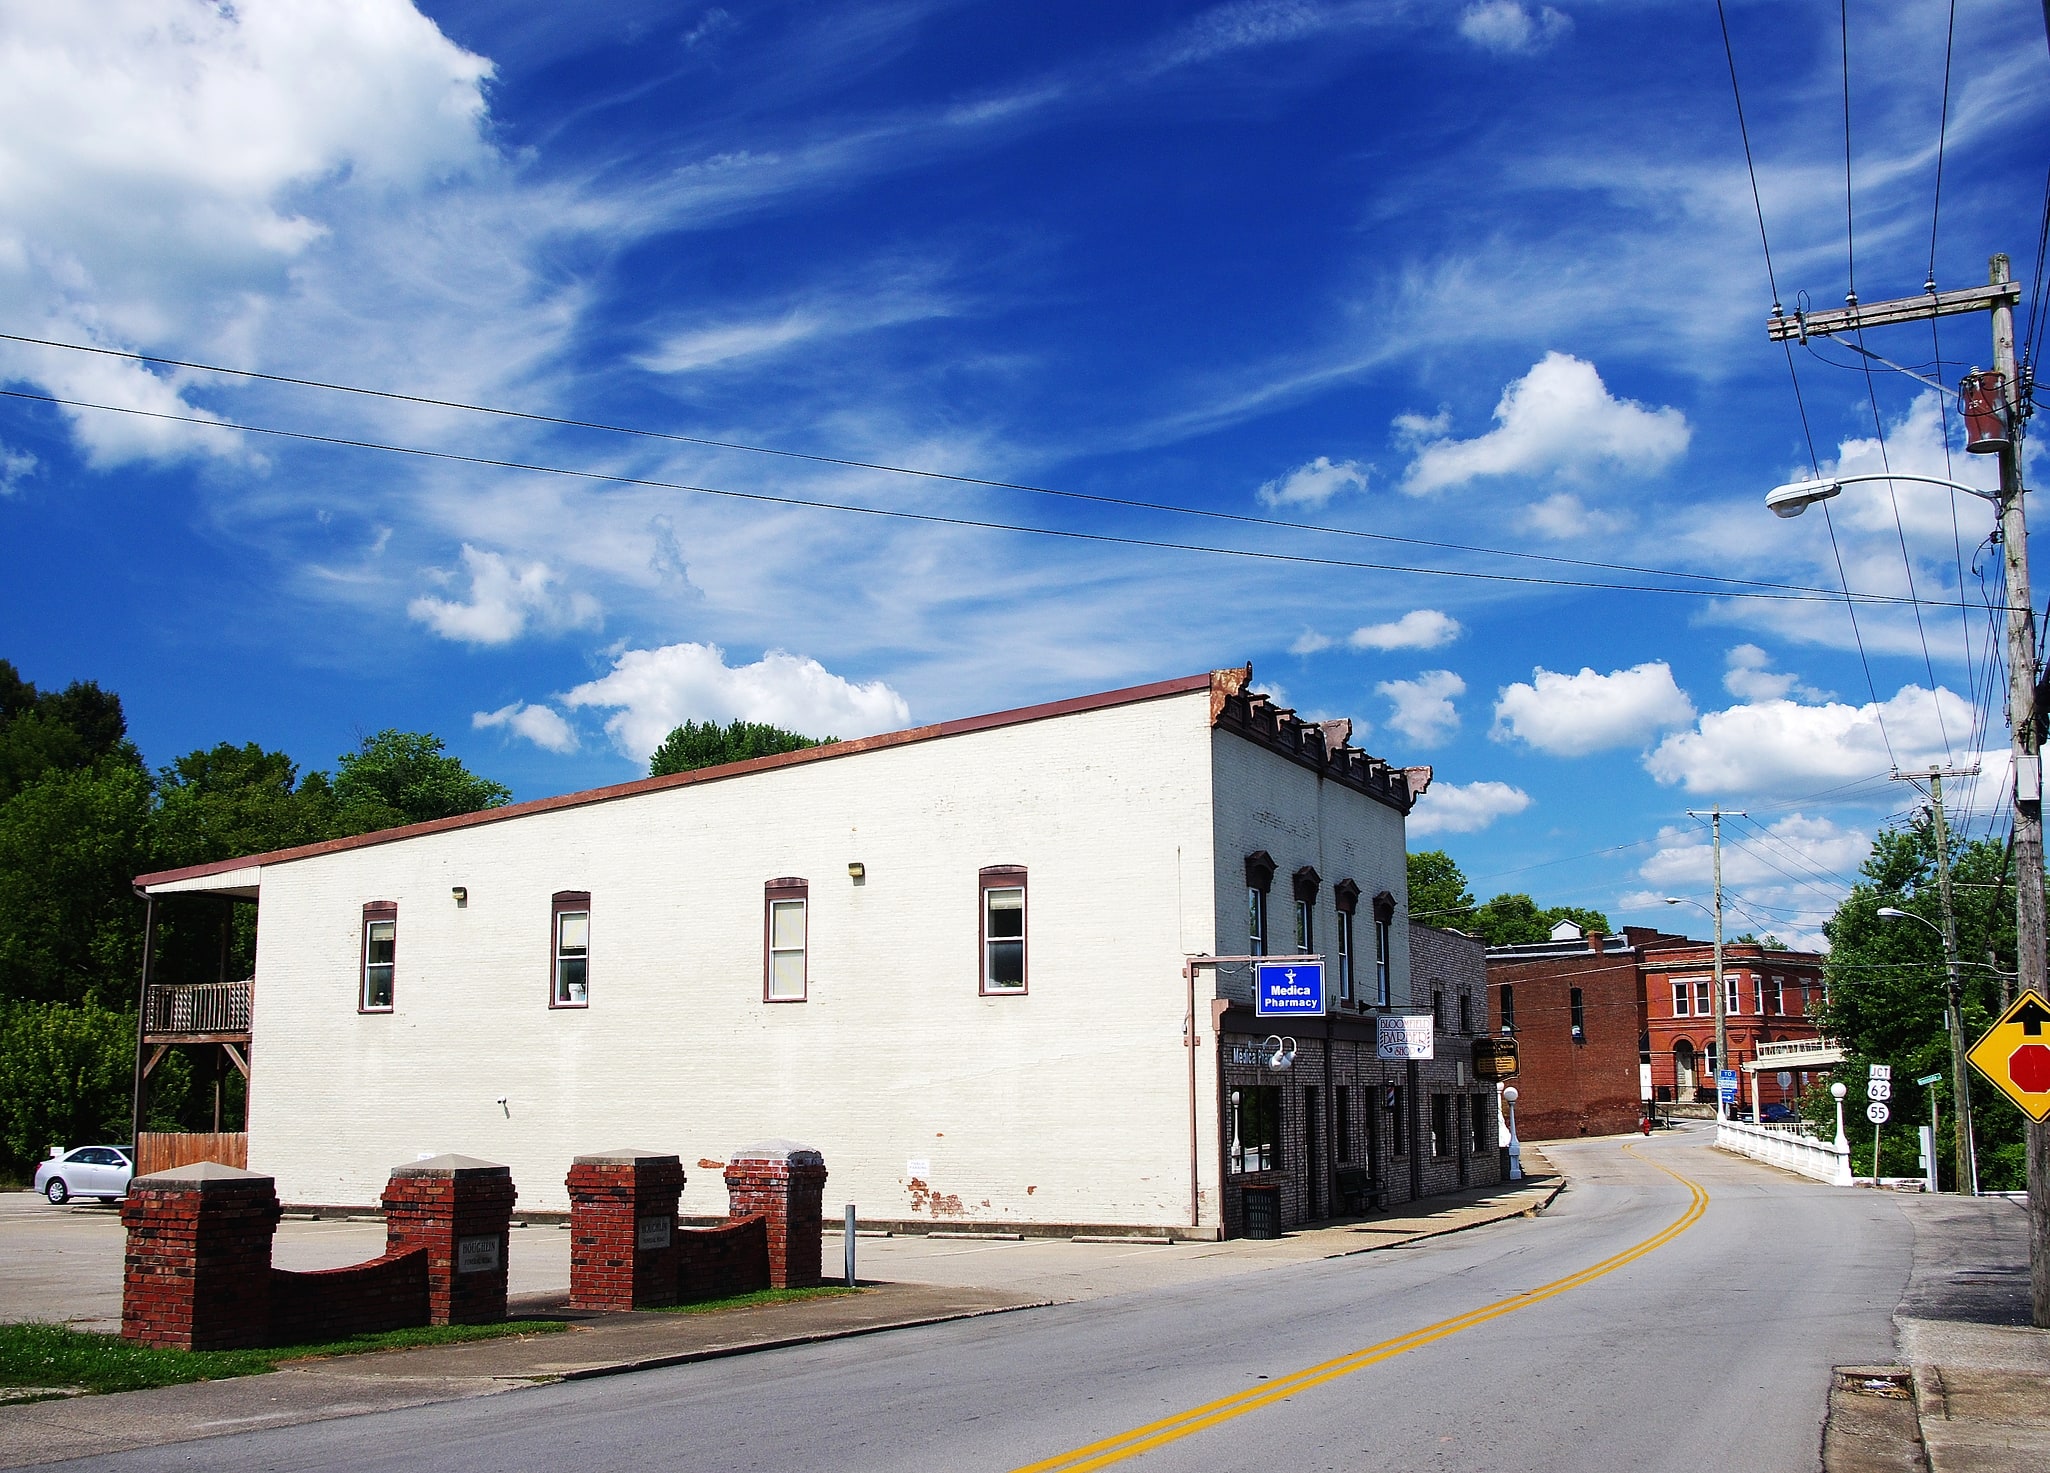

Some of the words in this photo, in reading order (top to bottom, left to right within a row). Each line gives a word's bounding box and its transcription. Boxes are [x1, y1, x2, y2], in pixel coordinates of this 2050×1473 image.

[1270, 985, 1311, 996] Medica
[1264, 998, 1318, 1009] Pharmacy
[1380, 1018, 1430, 1028] BLOOMFIELD
[1383, 1031, 1427, 1044] BARBER
[1233, 1047, 1256, 1064] Medica
[1394, 1046, 1416, 1056] SHOP
[1871, 1067, 1889, 1077] JCT
[1871, 1084, 1887, 1097] 62
[1871, 1106, 1885, 1119] 55
